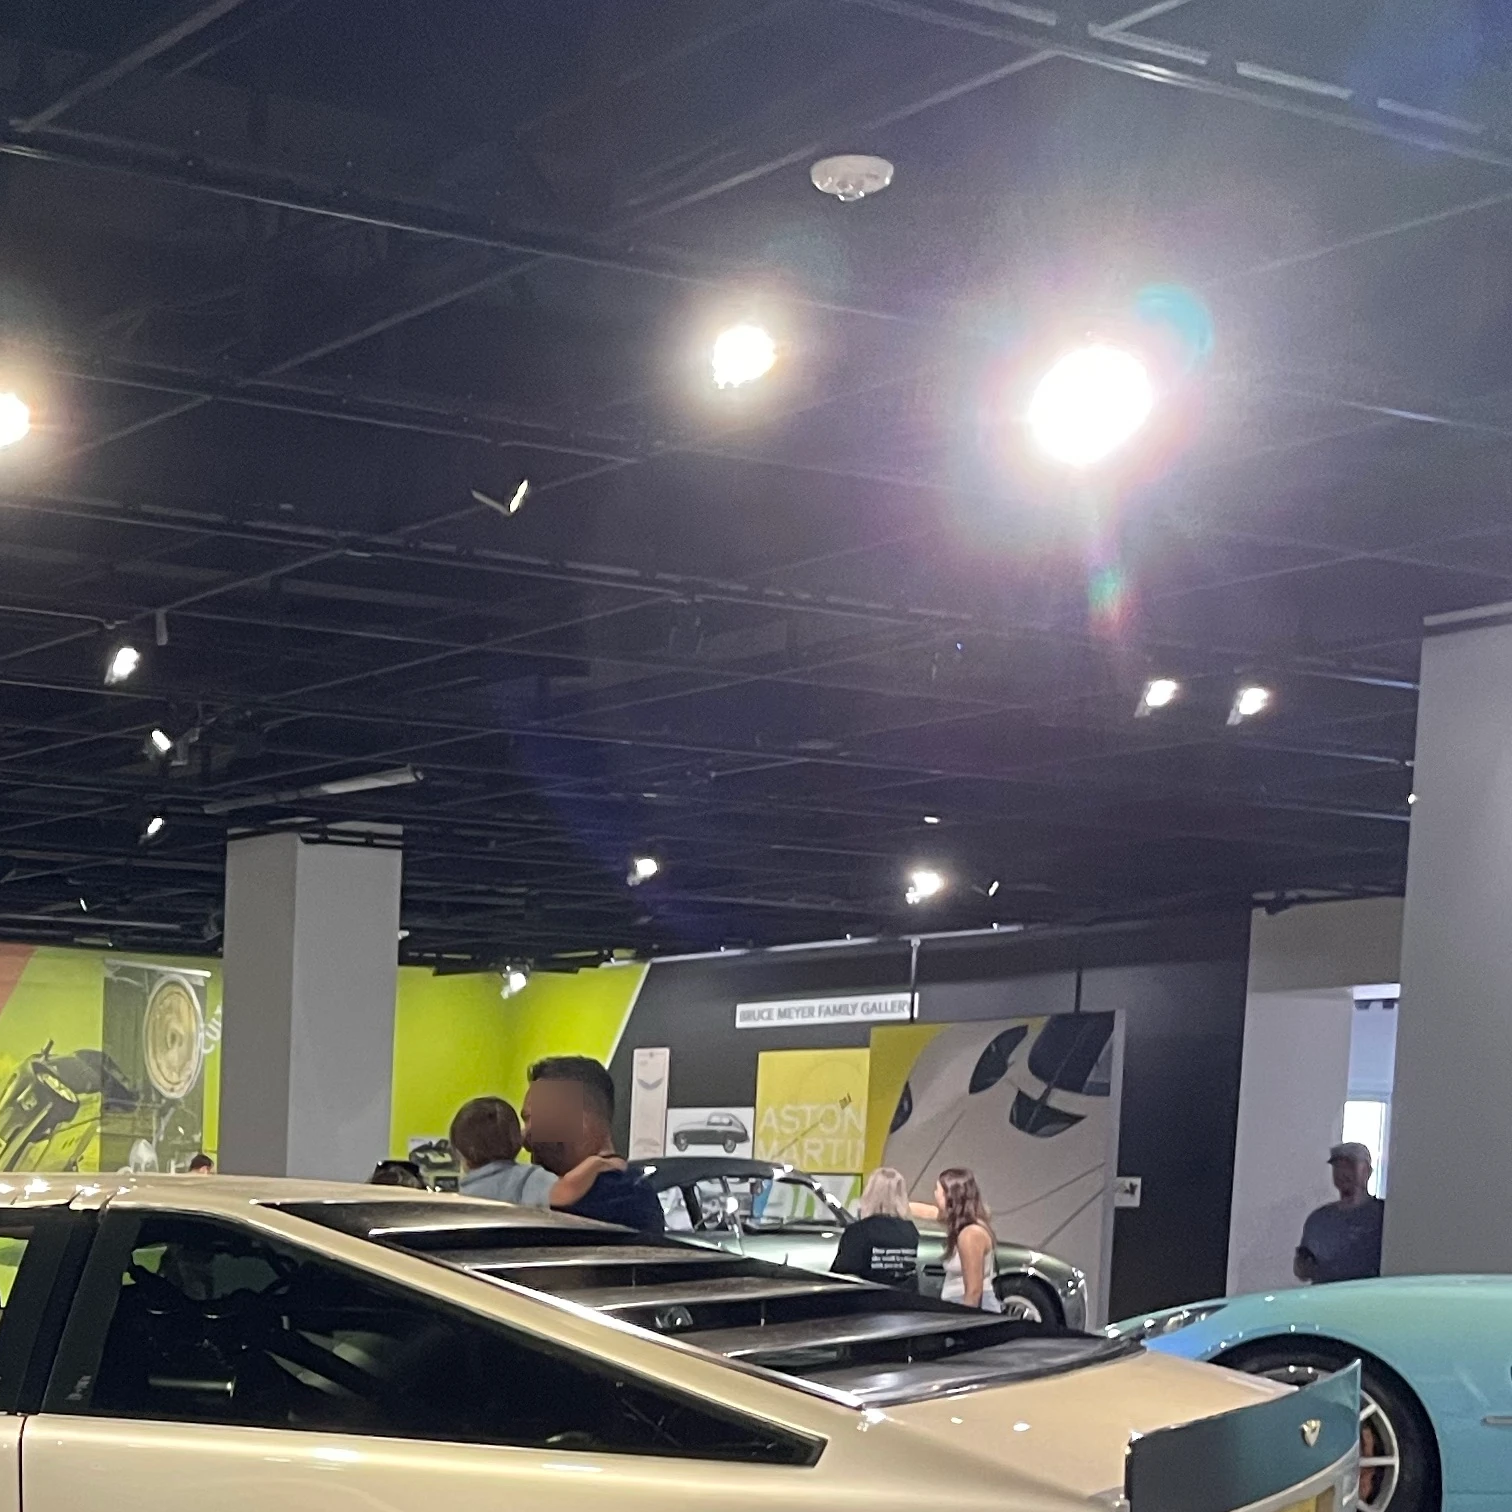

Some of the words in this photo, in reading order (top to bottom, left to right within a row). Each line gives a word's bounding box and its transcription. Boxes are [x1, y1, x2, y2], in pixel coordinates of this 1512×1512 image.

[739, 1007, 775, 1023] BRUCE
[777, 1005, 815, 1021] MEYER
[818, 1002, 858, 1018] FAMILY
[758, 1102, 865, 1136] ASTON
